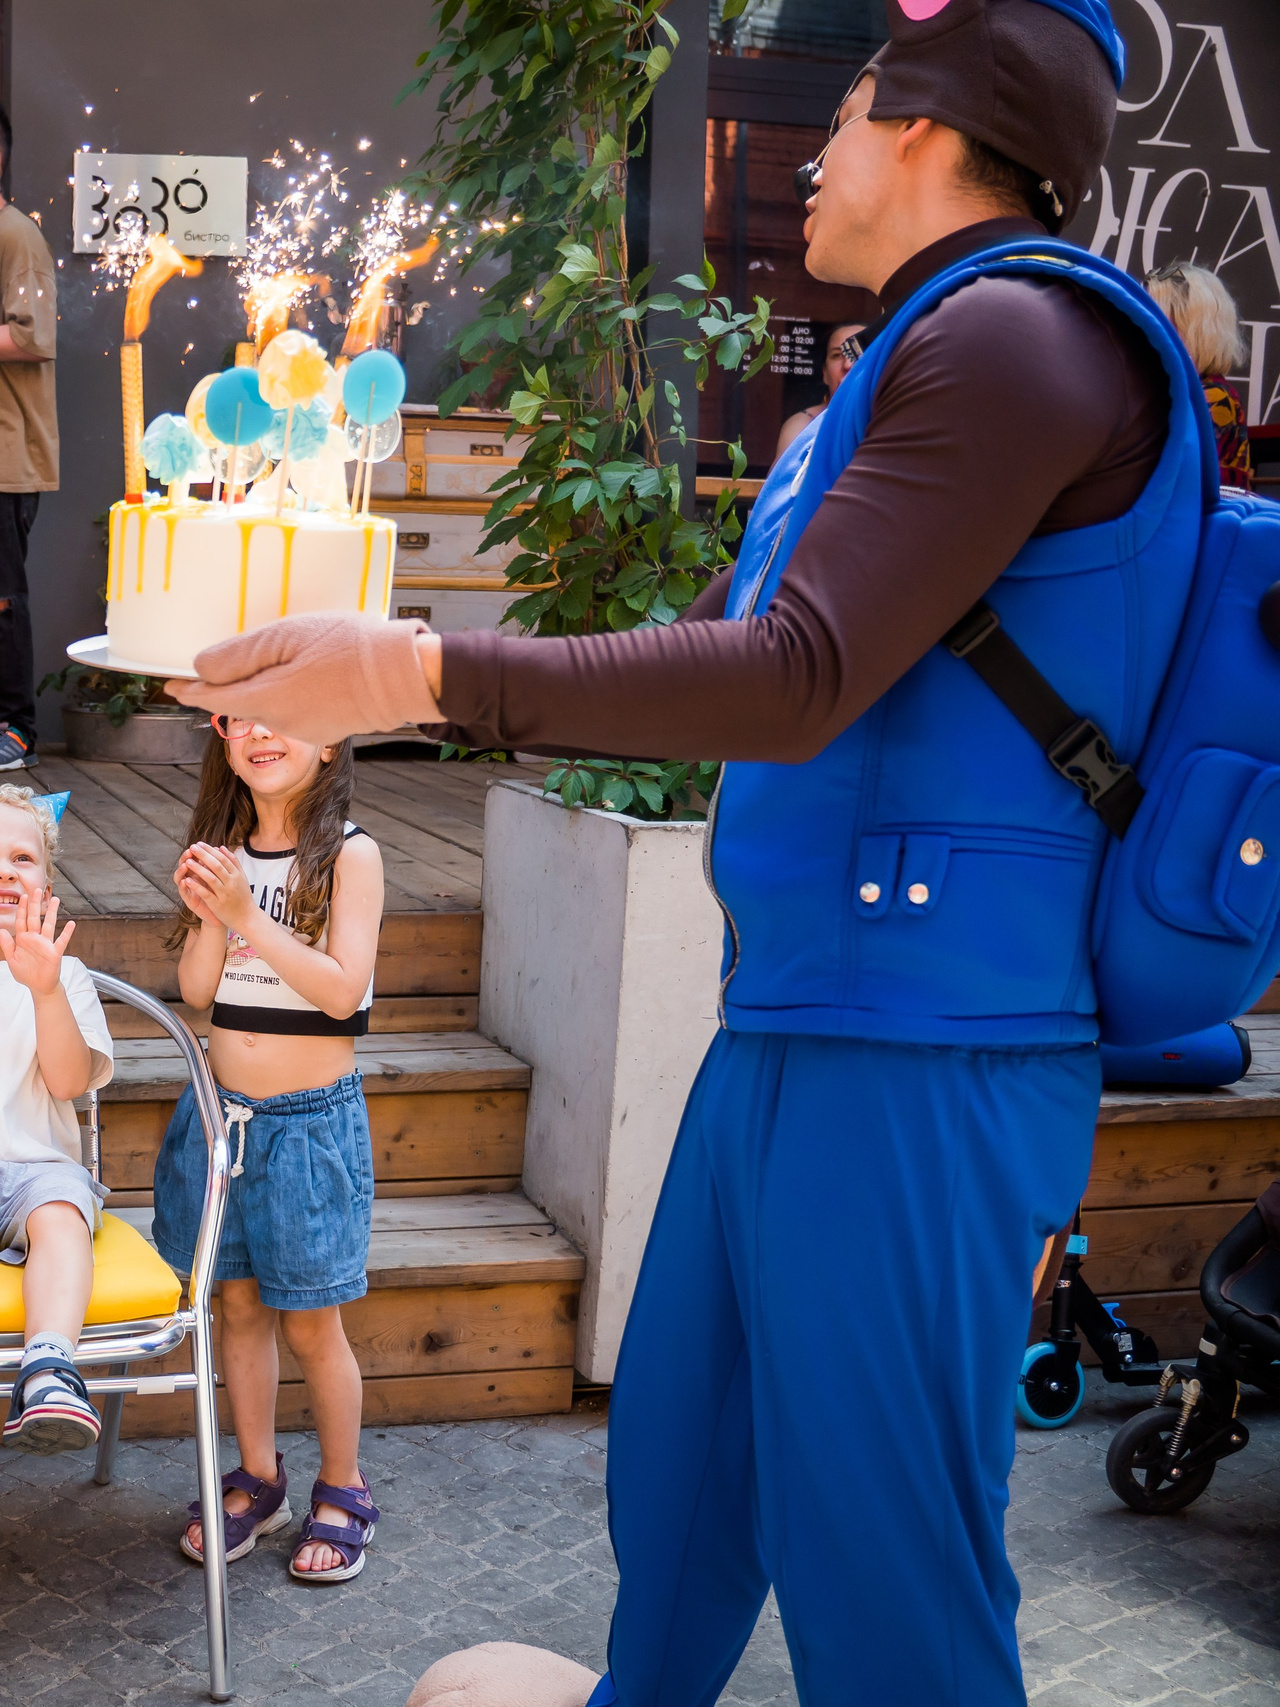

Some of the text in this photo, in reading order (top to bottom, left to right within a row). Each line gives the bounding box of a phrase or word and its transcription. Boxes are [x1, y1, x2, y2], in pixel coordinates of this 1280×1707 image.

[184, 230, 230, 243] бистро
[795, 336, 814, 345] 02:00
[771, 355, 790, 363] 12:00
[770, 365, 789, 373] 12:00
[793, 367, 813, 375] 00:00
[224, 971, 280, 986] WHO LOVES TENNIS
